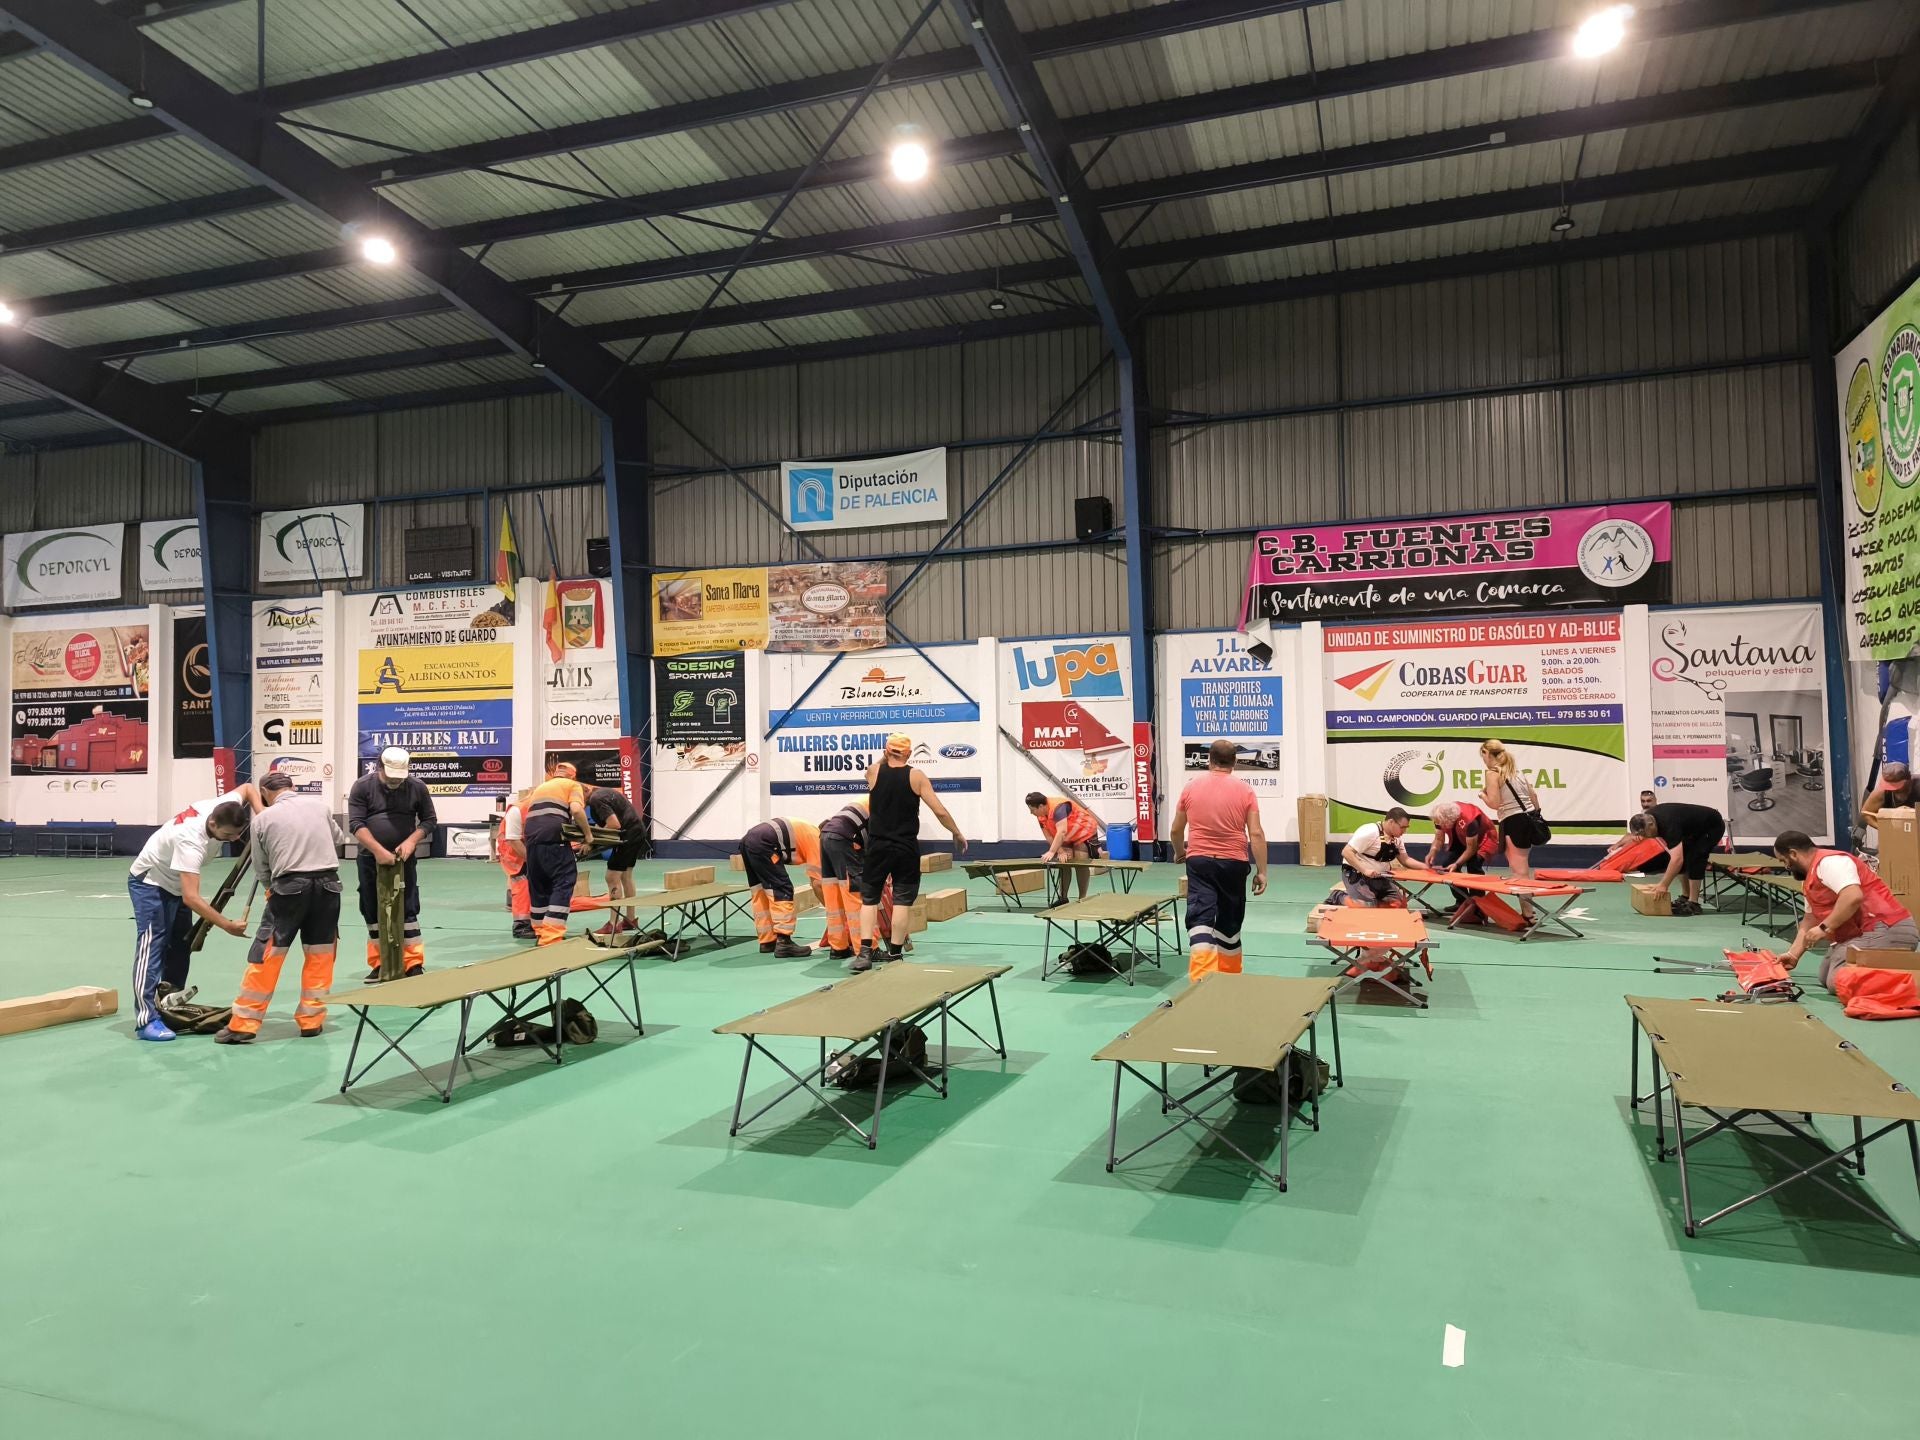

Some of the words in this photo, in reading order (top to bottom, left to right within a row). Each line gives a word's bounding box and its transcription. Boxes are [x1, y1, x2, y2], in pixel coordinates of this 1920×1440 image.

[839, 468, 918, 491] Diputación
[840, 495, 860, 510] DE
[865, 488, 938, 508] PALENCIA
[1879, 496, 1920, 529] PODEMO
[295, 536, 345, 549] DEPORCYL
[1257, 534, 1328, 556] C.B.
[1342, 516, 1551, 551] FUENTES
[1888, 524, 1917, 549] POCO,
[174, 548, 202, 559] DEPOR
[1271, 540, 1535, 576] CARRIONAS
[39, 557, 111, 577] DEPORCYL
[1862, 553, 1904, 578] JUNTOS
[409, 572, 433, 580] LOCAL
[441, 569, 472, 578] VISITANTE
[406, 587, 485, 601] COMBUSTIBLES
[705, 584, 730, 601] Santa
[732, 582, 760, 599] Marta
[1271, 583, 1382, 616] Sentimiento
[1388, 586, 1416, 605] de
[1424, 586, 1469, 601] una
[1476, 581, 1565, 603] Comarca
[376, 631, 442, 647] AYUNTAMIENTO
[445, 630, 455, 643] DE
[458, 628, 497, 642] GUARDO
[1328, 631, 1371, 647] UNIDAD
[1374, 631, 1389, 645] DE
[1392, 627, 1466, 645] SUMINISTRO
[1470, 626, 1486, 642] DE
[1489, 622, 1545, 640] GASÓLEO
[1548, 623, 1557, 637] Y
[1560, 620, 1616, 637] AD-BLUE
[1216, 638, 1246, 656] J.L.
[1579, 646, 1616, 654] VIERNES
[424, 661, 480, 670] EXCAVACIONES
[667, 659, 736, 671] GDESING
[1012, 642, 1120, 697] lupa
[1190, 655, 1272, 673] ALVAREZ
[408, 670, 451, 682] ALBINO
[453, 669, 497, 680] SANTOS
[547, 664, 592, 687] AXIS
[668, 671, 733, 680] SPORTWEAR
[1705, 667, 1761, 678] peluquería
[1764, 668, 1770, 676] y
[1772, 665, 1813, 675] estética
[1202, 681, 1261, 694] TRANSPORTES
[1400, 690, 1454, 698] COOPERATIVA
[1469, 687, 1528, 696] TRANSPORTES
[271, 693, 290, 702] HOTEL
[1190, 695, 1217, 708] VENTA
[1220, 695, 1230, 708] DE
[1233, 694, 1274, 707] BIOMASA
[27, 707, 65, 716] 979.850.991
[182, 700, 211, 710] SANT
[551, 712, 613, 726] disenove
[806, 712, 831, 722] VENTA
[833, 711, 839, 720] Y
[840, 708, 887, 721] REPARACIÓN
[889, 709, 900, 718] DE
[903, 707, 946, 718] VEHÍCULOS
[1195, 710, 1217, 721] VENTA
[1220, 710, 1228, 720] DE
[1230, 709, 1269, 720] CARBONES
[1336, 715, 1357, 724] POL.
[1358, 715, 1375, 723] IND.
[1376, 712, 1437, 723] CAMPONDÓN.
[1438, 713, 1477, 721] GUARDO
[1480, 712, 1534, 722] (PALENCIA).
[1536, 711, 1555, 719] TEL.
[1557, 710, 1574, 718] 979
[1575, 710, 1586, 718] 85
[1588, 710, 1598, 718] 30
[1601, 710, 1611, 718] 61
[27, 717, 65, 727] 979.891.328
[1196, 723, 1201, 732] Y
[1203, 721, 1220, 733] LEÑA
[1222, 722, 1228, 732] A
[1230, 721, 1268, 732] DOMICILIO
[371, 731, 451, 747] TALLERES
[457, 730, 499, 745] RAUL
[1034, 726, 1080, 739] MAP
[777, 735, 839, 752] TALLERES
[1029, 740, 1065, 748] GUARDO
[946, 746, 969, 757] Ford
[409, 762, 438, 770] ECIALISTAS
[486, 760, 500, 769] KIA
[804, 755, 811, 772] E
[814, 754, 853, 772] HIJOS
[440, 785, 462, 793] HORAS
[622, 770, 633, 804] MAP
[1136, 761, 1150, 820] MAPFRE
